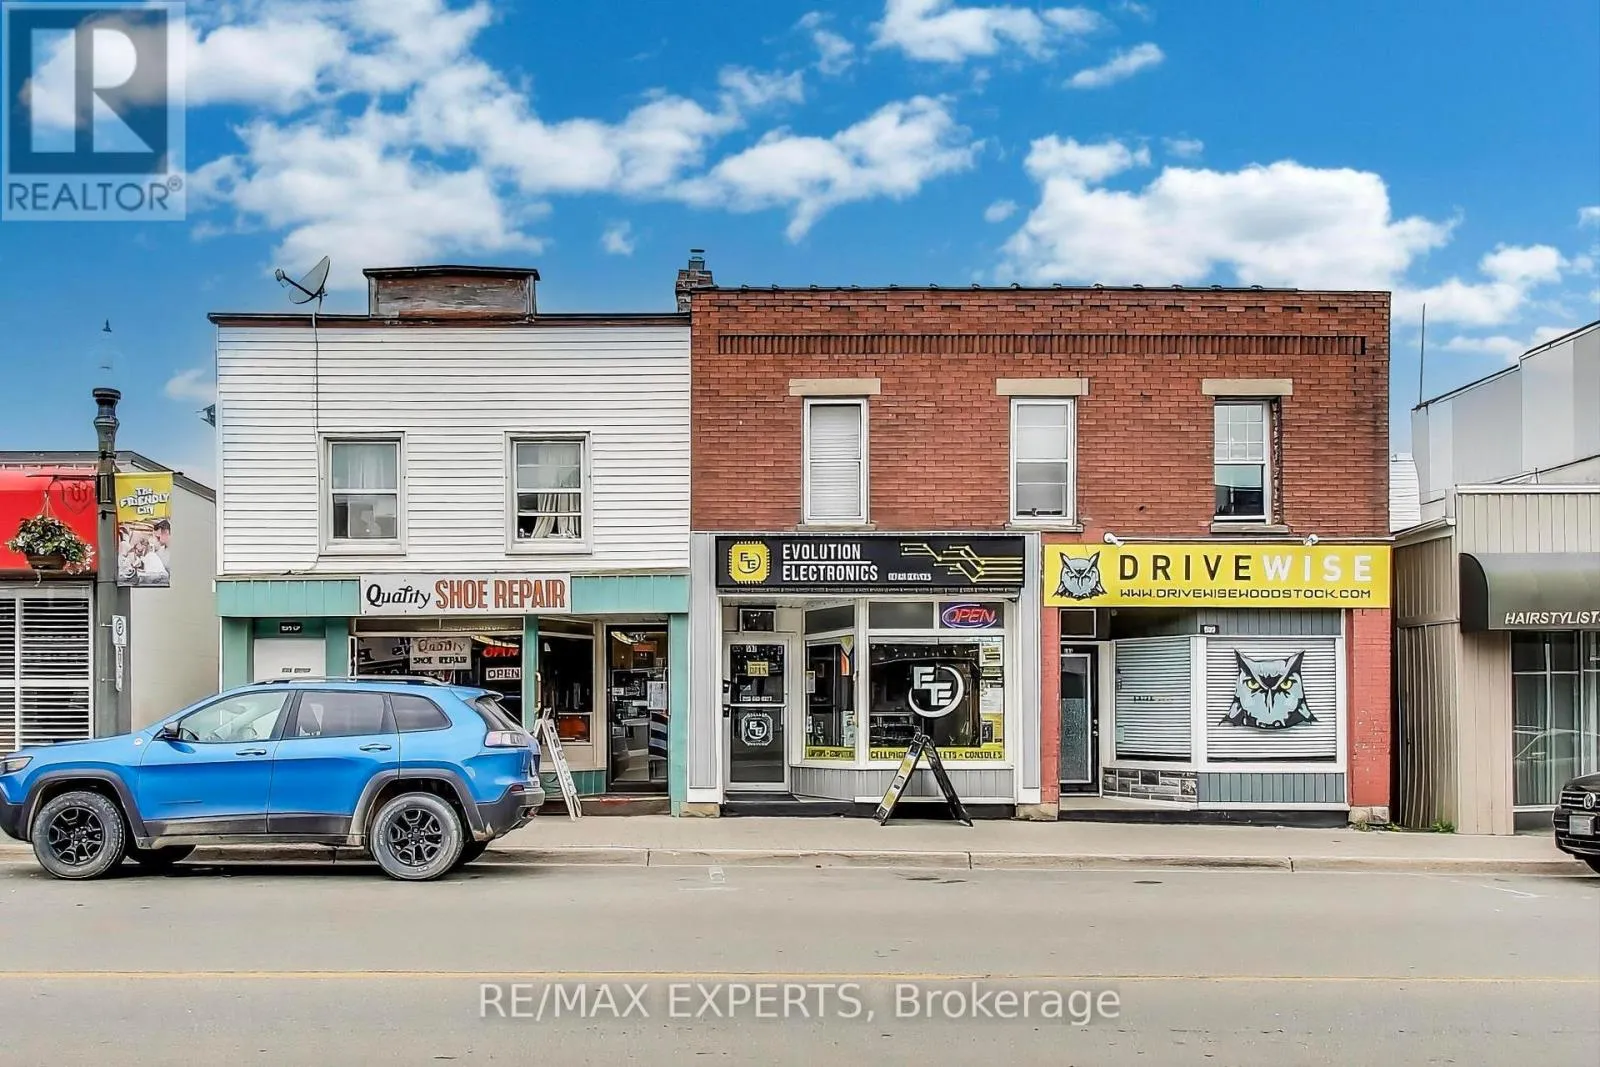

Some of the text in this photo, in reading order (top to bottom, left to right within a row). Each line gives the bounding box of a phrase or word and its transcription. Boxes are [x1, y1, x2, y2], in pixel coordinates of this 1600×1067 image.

[120, 493, 170, 508] FRIENDLY
[783, 544, 861, 560] EVOLUTION
[783, 565, 878, 581] ELECTRONICS
[366, 579, 566, 609] Quality SHOE REPAIR
[1120, 588, 1371, 599] WWW.DRIVEWISEWOODSTOCK.COM
[945, 608, 995, 623] OPEN
[413, 656, 468, 665] SHOE REPAIR
[488, 668, 520, 679] OPEN
[964, 750, 1003, 759] CONSOLES
